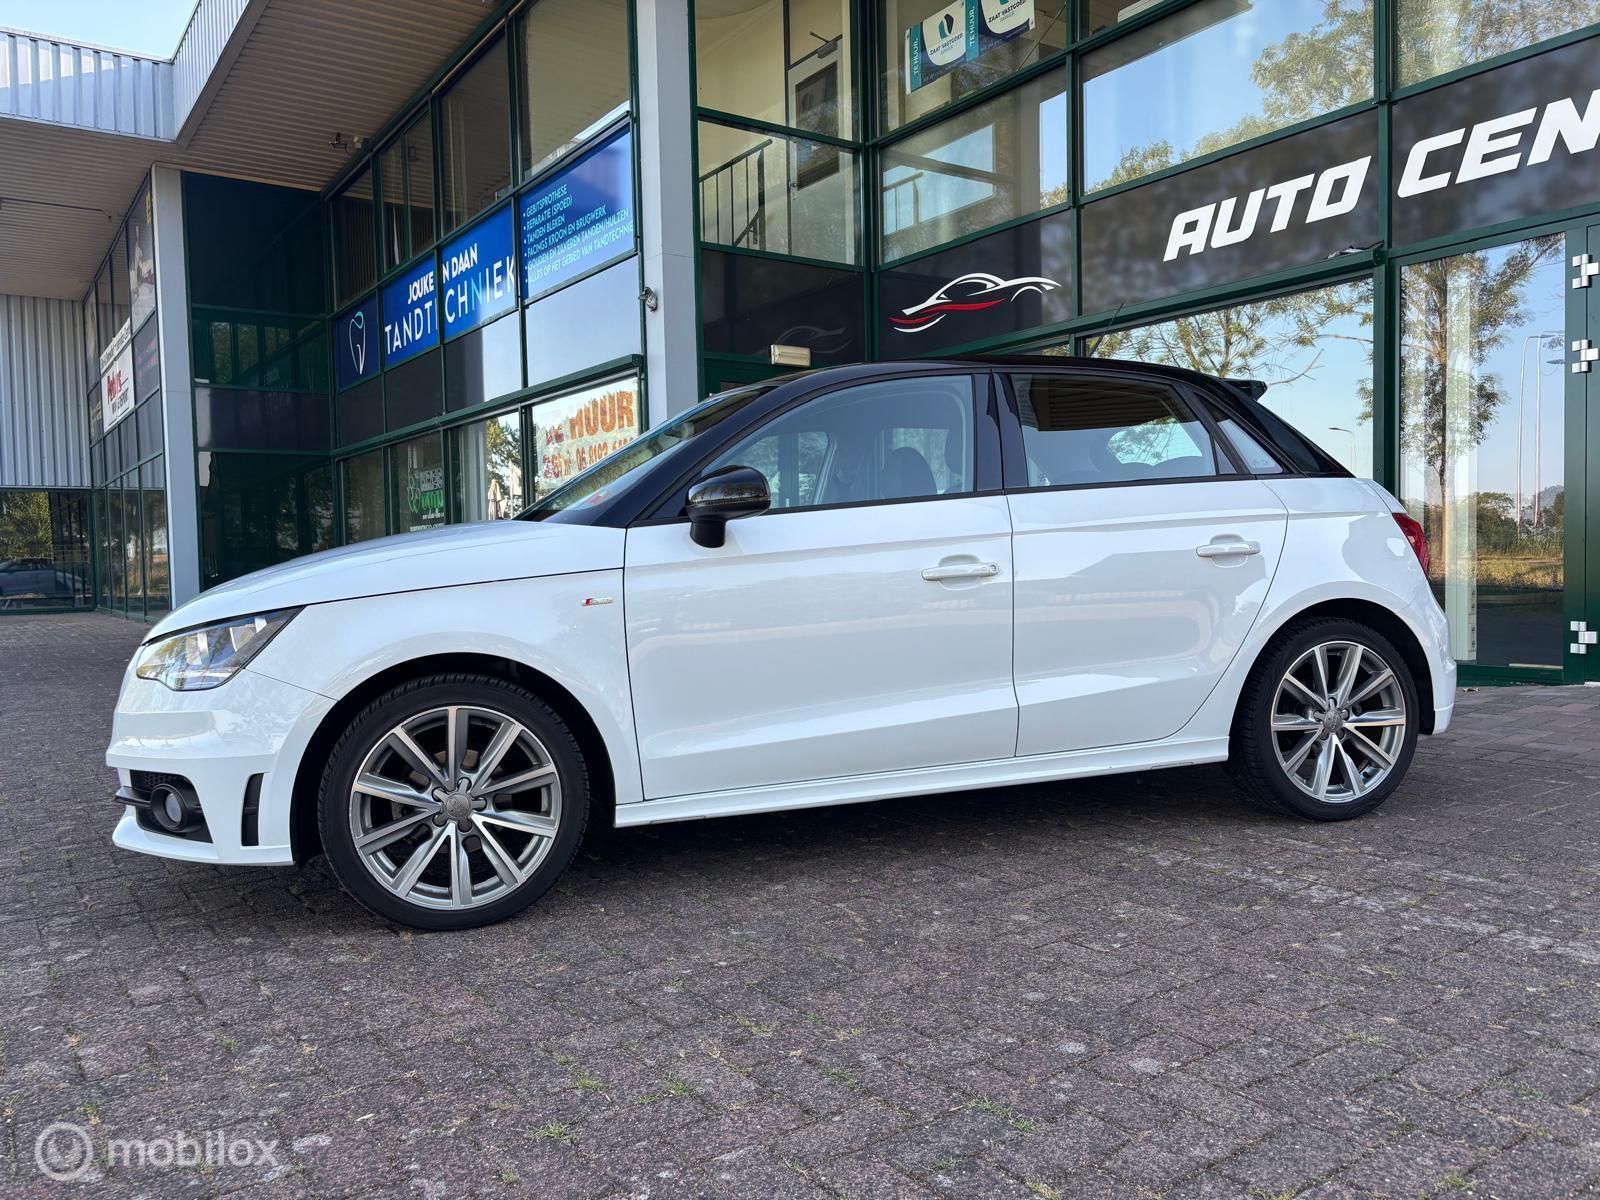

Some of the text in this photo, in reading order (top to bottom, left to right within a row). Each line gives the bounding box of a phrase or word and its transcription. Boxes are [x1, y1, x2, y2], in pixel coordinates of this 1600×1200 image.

[526, 184, 568, 217] GEBITSPROTHESE
[526, 194, 573, 232] REPARATIE (SPOED)
[1163, 155, 1372, 262] AUTO
[527, 213, 566, 244] TANDEN BLEKEN
[527, 204, 606, 258] FACINGS KROON EN BRUGWERK
[593, 220, 633, 250] TANDTECHNIE
[408, 270, 435, 305] JOUKE
[451, 242, 478, 280] DAAN
[385, 253, 516, 356] TANDTCHNIEK
